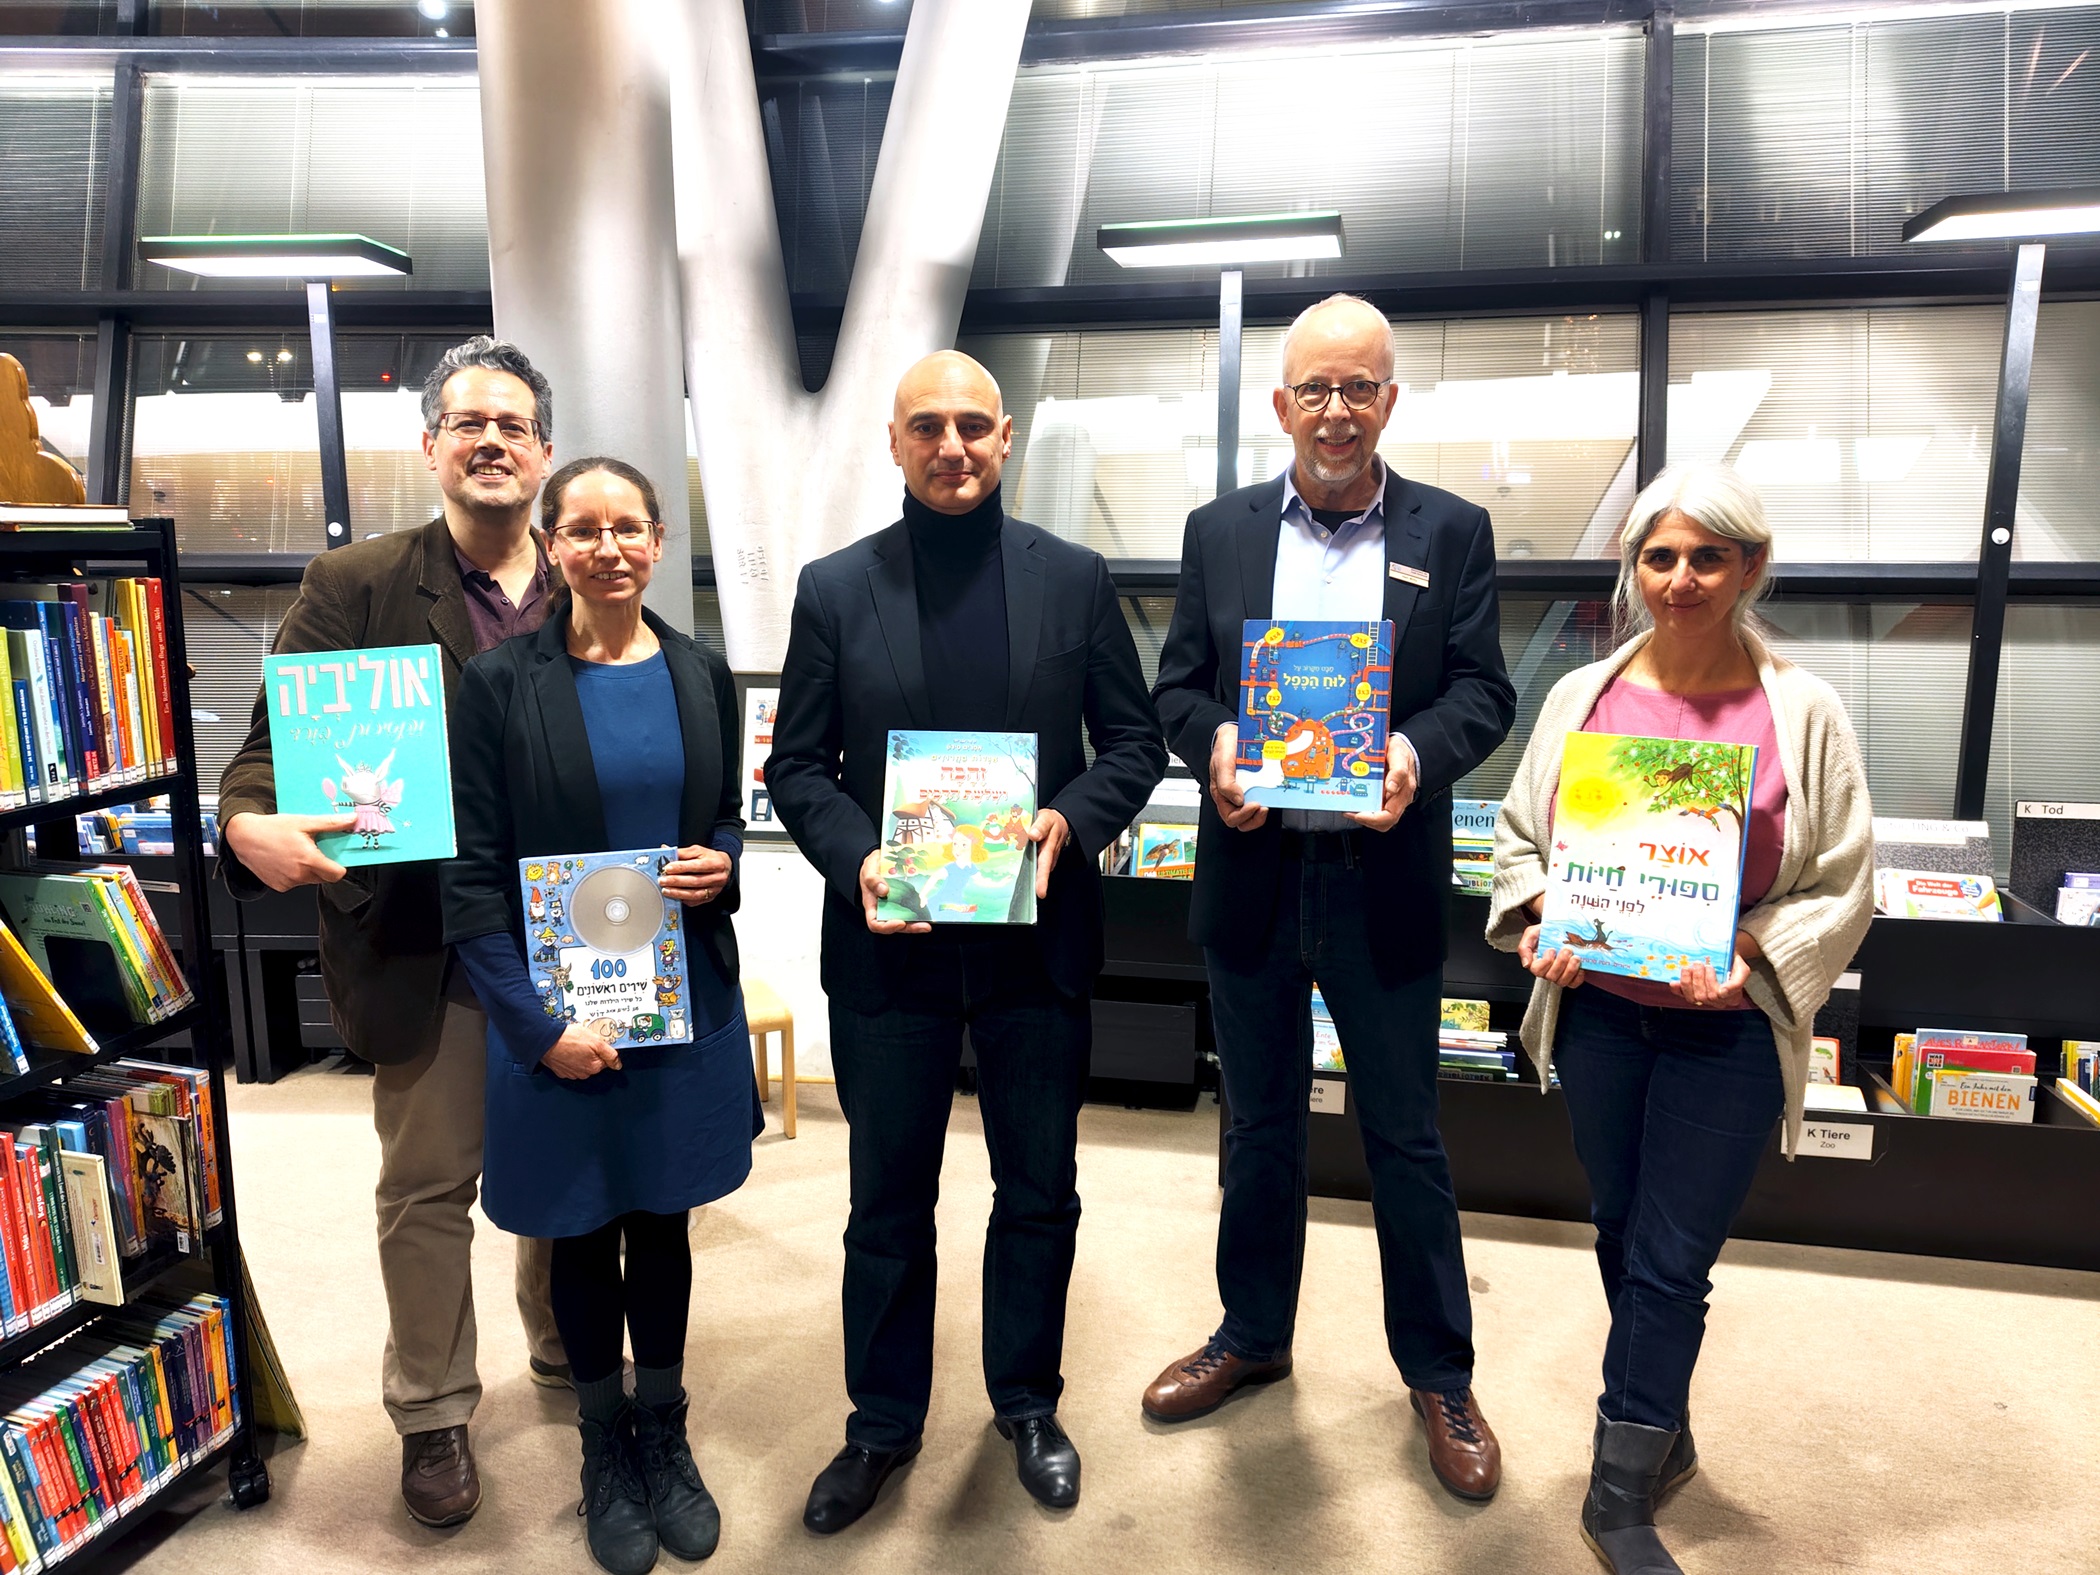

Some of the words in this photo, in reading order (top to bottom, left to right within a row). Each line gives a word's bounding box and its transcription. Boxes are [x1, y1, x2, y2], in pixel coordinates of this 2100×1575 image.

[157, 643, 165, 658] fliegt
[2024, 805, 2031, 814] K
[2042, 805, 2064, 814] Tod
[1454, 814, 1495, 828] enen
[1912, 886, 1959, 896] Fahrzeuge
[590, 958, 626, 980] 100
[1310, 1086, 1324, 1094] ere
[1948, 1090, 2020, 1111] BIENEN
[1807, 1128, 1817, 1138] K
[1820, 1129, 1850, 1140] Tiere
[1820, 1141, 1835, 1149] Zoo
[34, 1195, 46, 1218] Kaya
